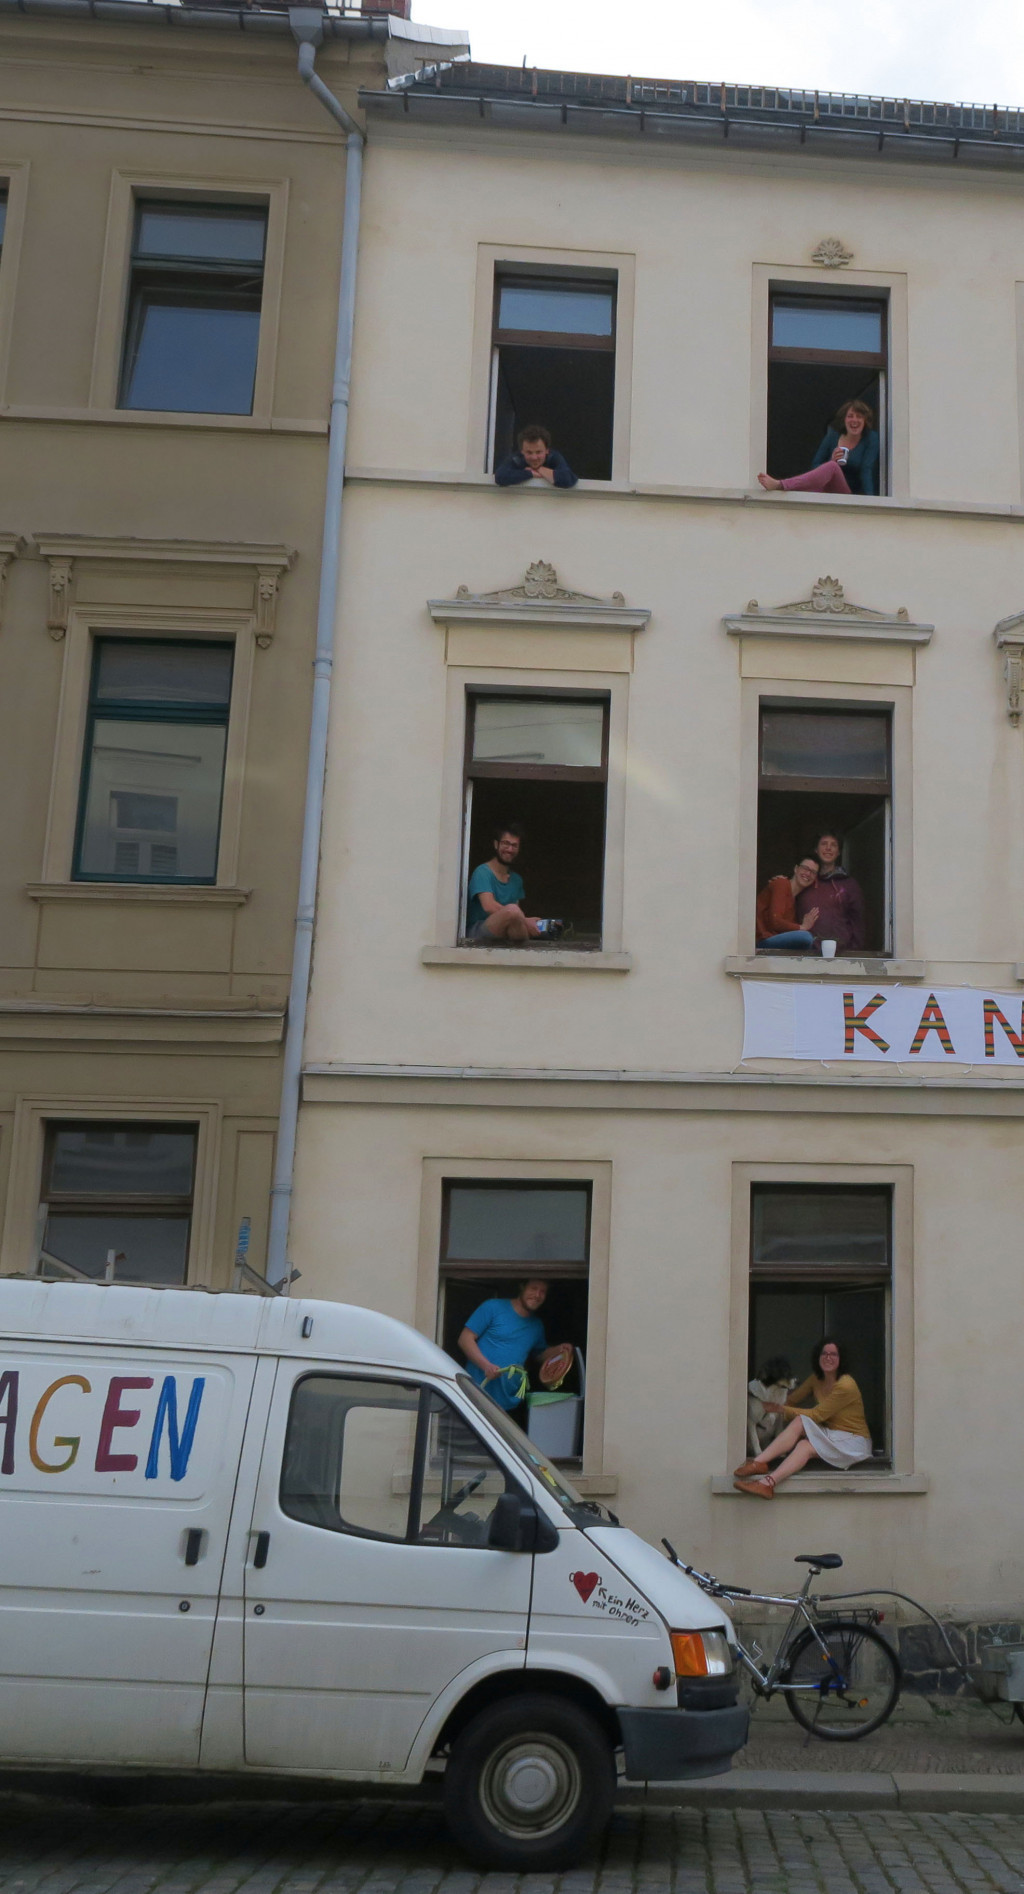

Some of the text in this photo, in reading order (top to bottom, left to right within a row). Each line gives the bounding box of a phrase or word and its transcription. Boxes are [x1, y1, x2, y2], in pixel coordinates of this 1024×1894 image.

[592, 1599, 639, 1627] mit Ohren
[607, 1594, 650, 1620] Ein Herz
